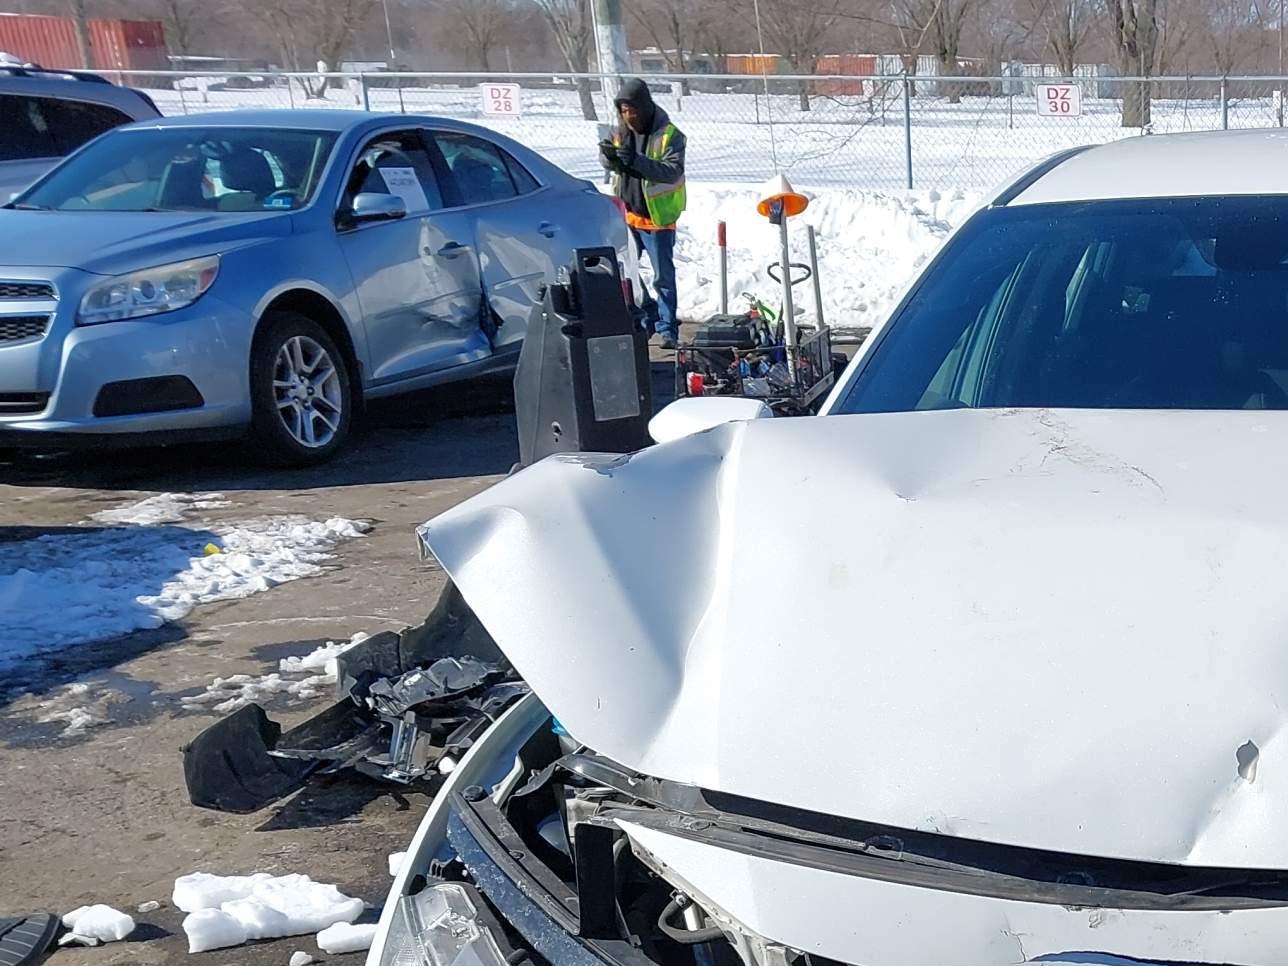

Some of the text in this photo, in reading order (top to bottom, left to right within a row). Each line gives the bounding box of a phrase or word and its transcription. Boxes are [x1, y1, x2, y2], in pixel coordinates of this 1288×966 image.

[490, 87, 512, 100] DZ
[1046, 87, 1072, 100] DZ
[493, 100, 513, 112] 28
[1049, 100, 1070, 113] 30
